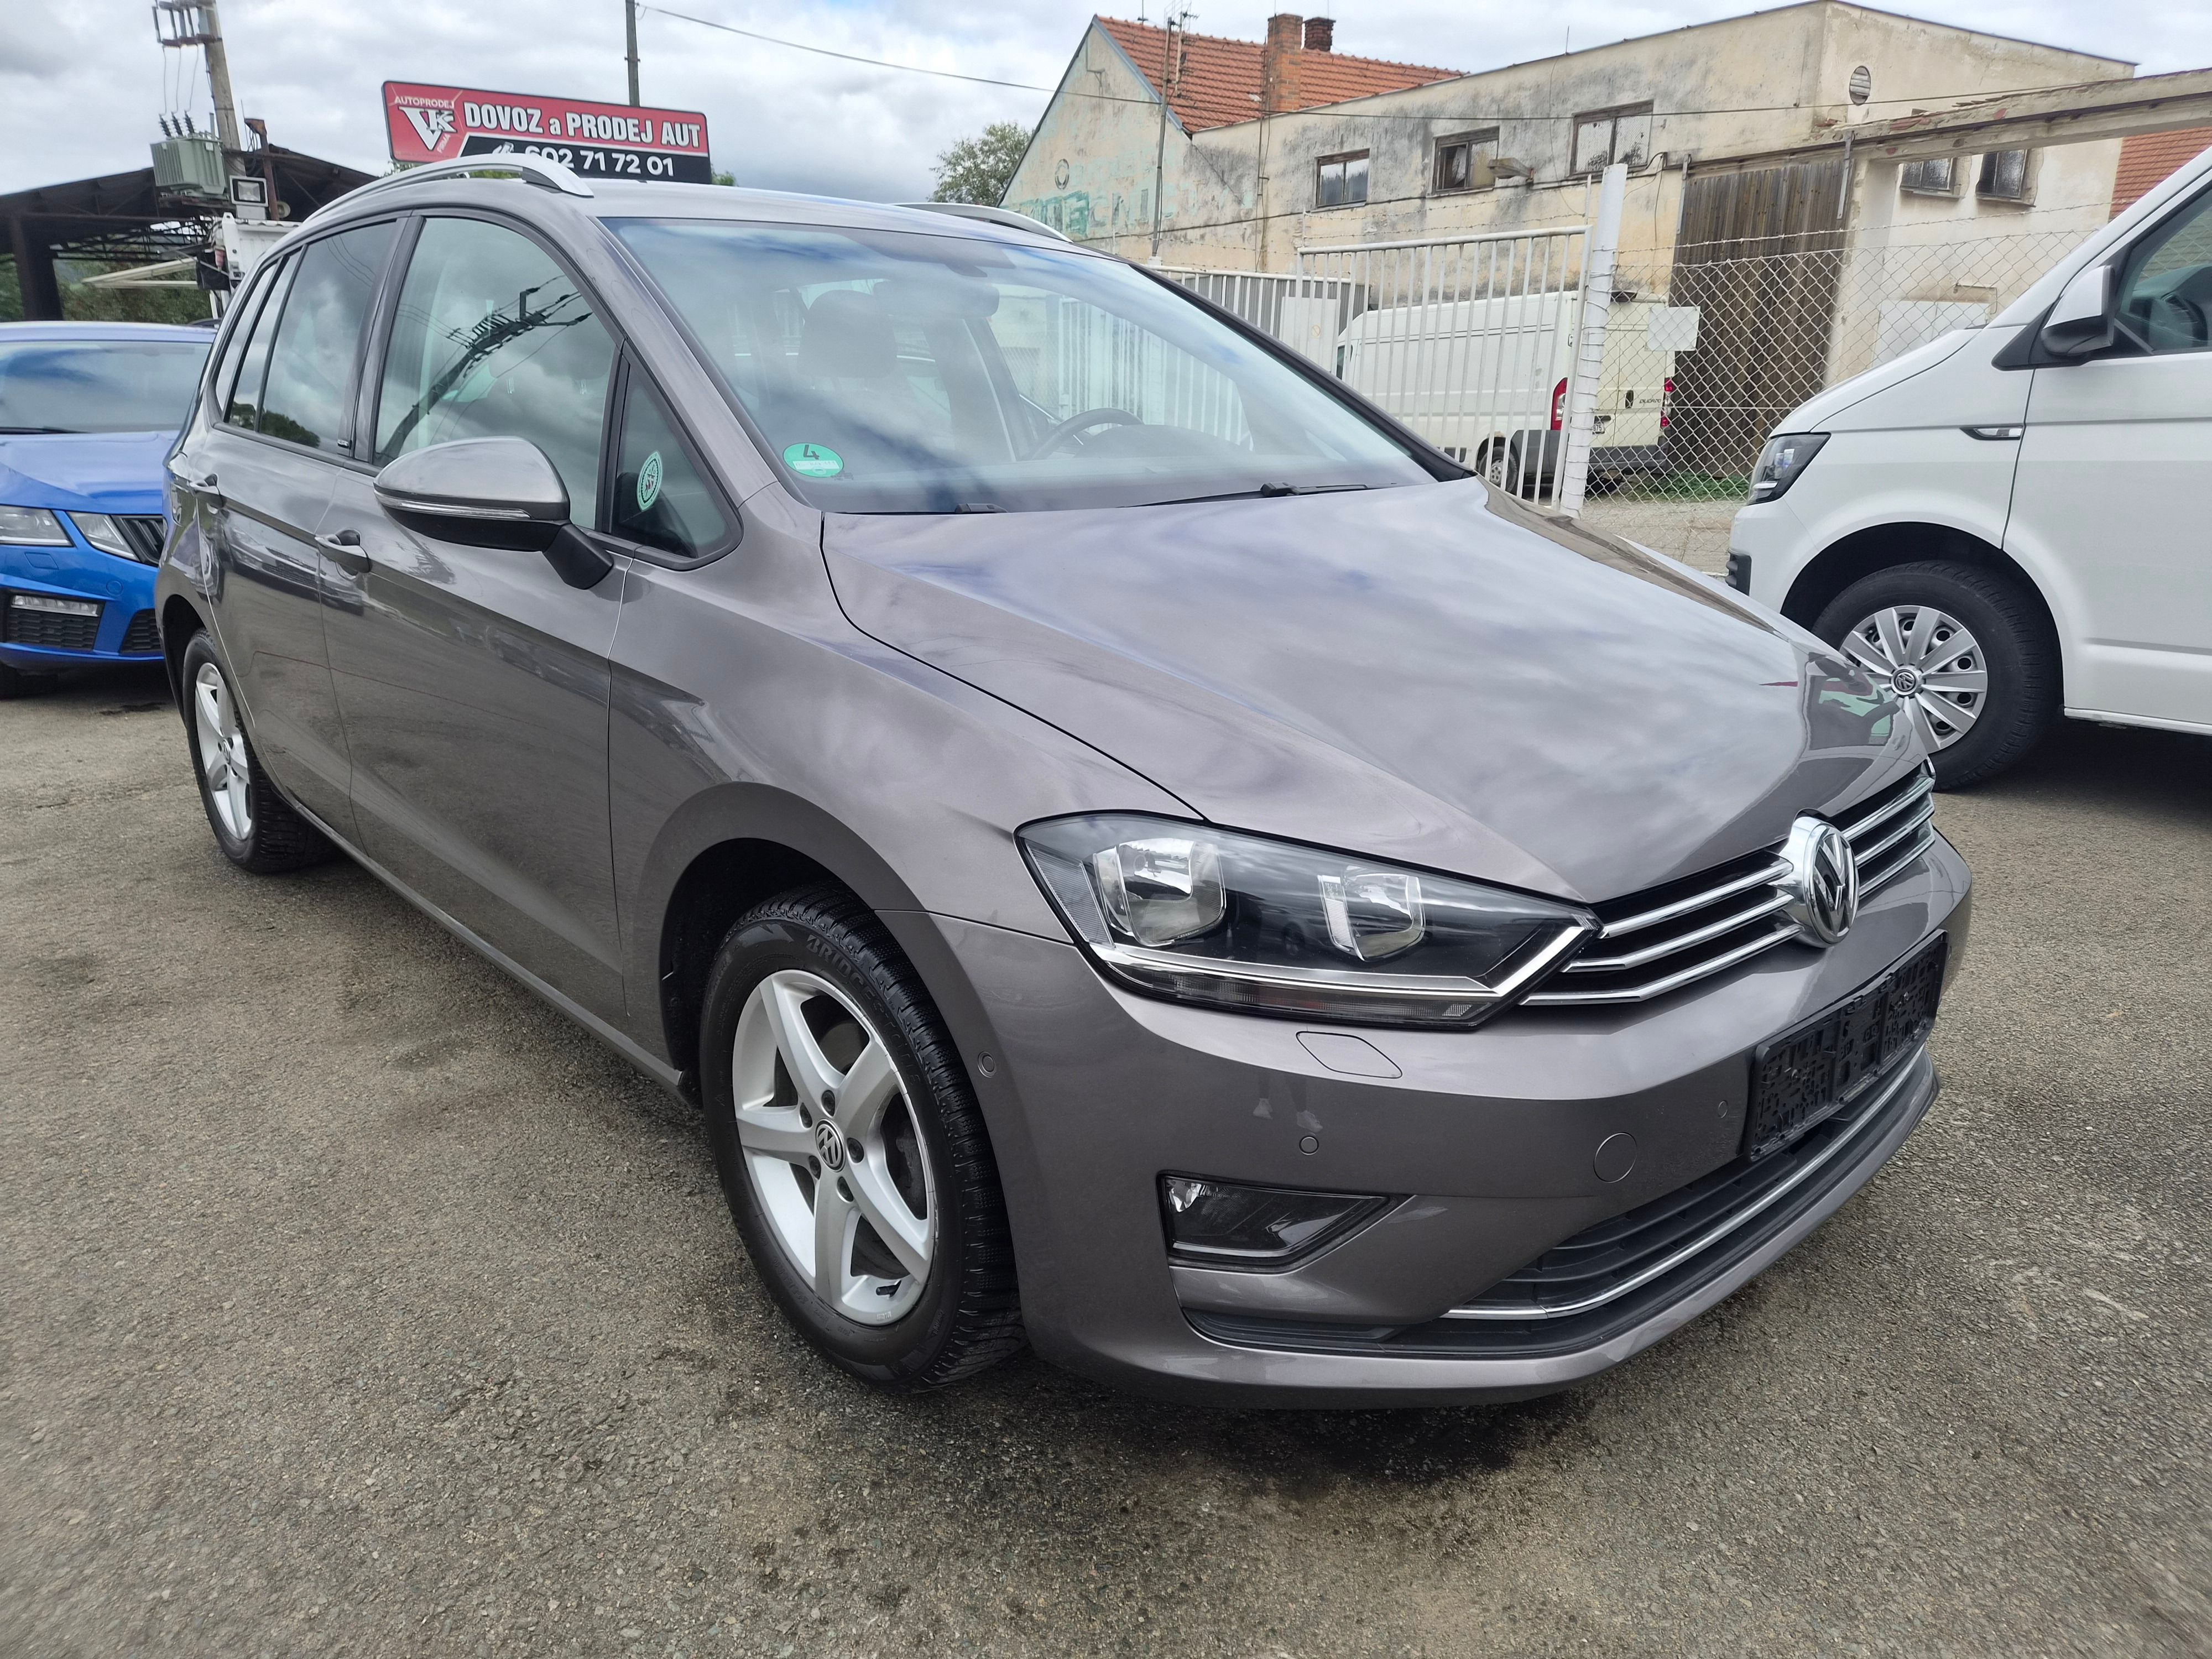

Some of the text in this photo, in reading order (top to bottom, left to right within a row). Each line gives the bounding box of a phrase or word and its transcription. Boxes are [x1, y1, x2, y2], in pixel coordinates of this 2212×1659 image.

[394, 96, 454, 109] AUTOPRODEJ
[463, 101, 701, 148] DOVOZ a PRODEJ AUT
[580, 150, 606, 171] 71
[612, 153, 641, 174] 72
[646, 155, 674, 177] 01
[803, 444, 820, 460] 4
